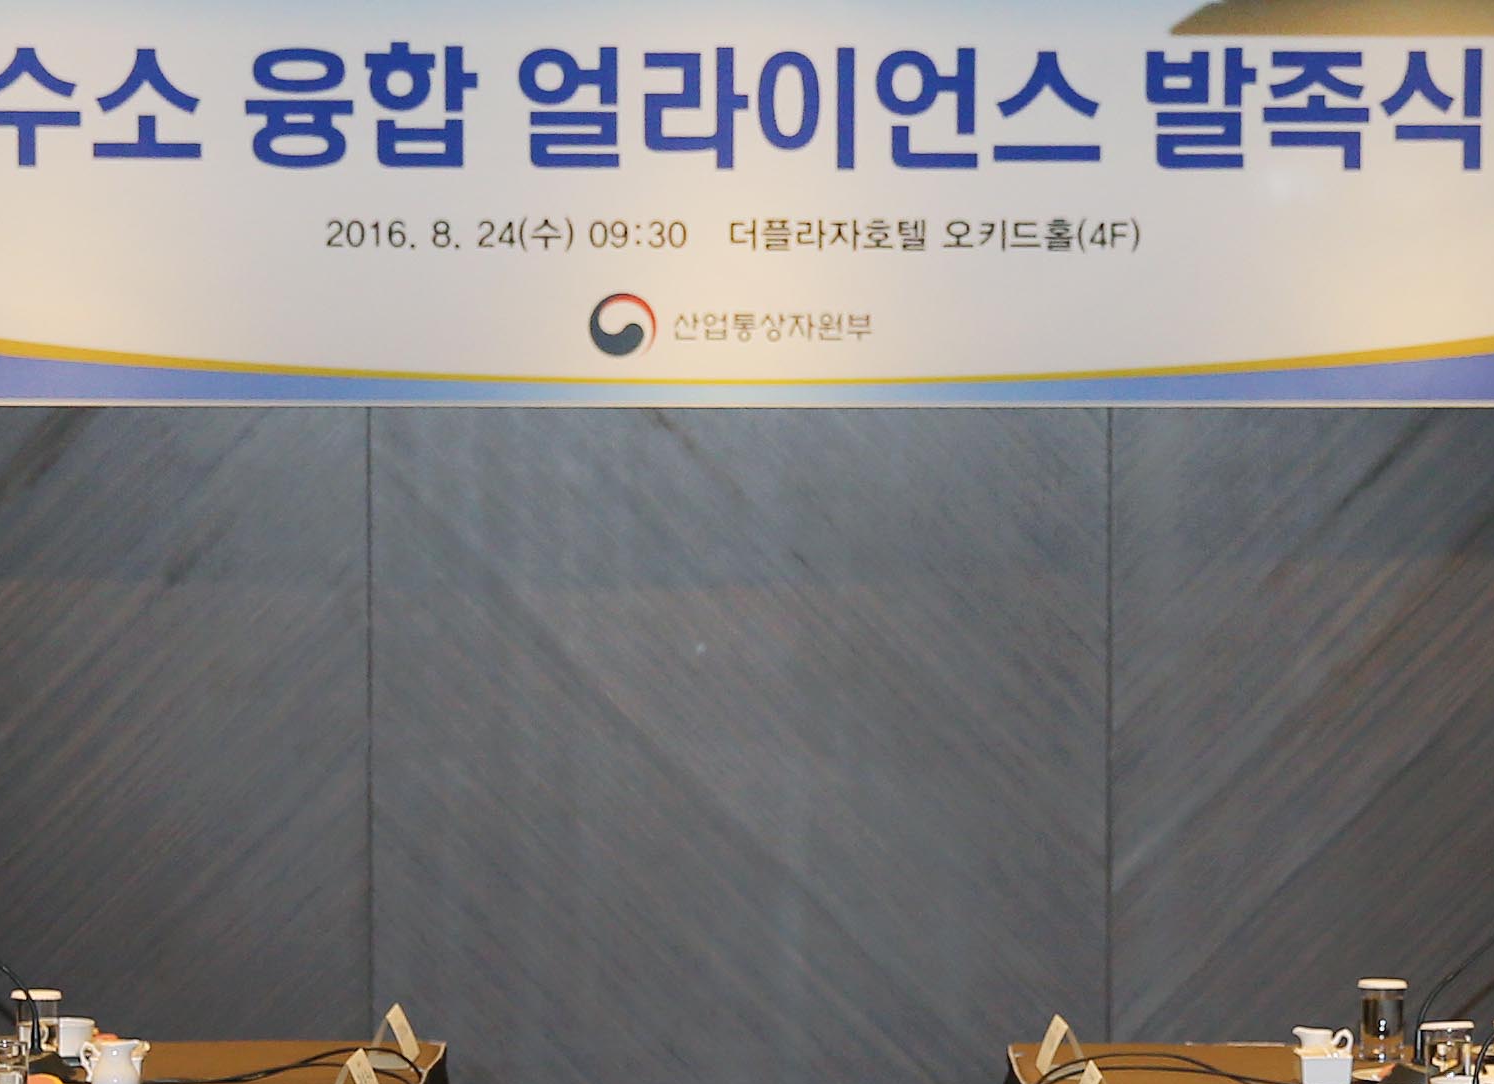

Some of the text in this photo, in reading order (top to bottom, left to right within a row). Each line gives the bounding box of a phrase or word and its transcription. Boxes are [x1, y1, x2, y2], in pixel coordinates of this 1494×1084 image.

[245, 41, 479, 169] 융합
[518, 46, 1101, 171] 얼라이언스
[1145, 46, 1484, 171] 발족식
[325, 217, 1141, 254] 2016. 8. 24(수) 09:30 더플라자호텔 오키드홀(4F)
[674, 311, 873, 343] 산업통상자원부
